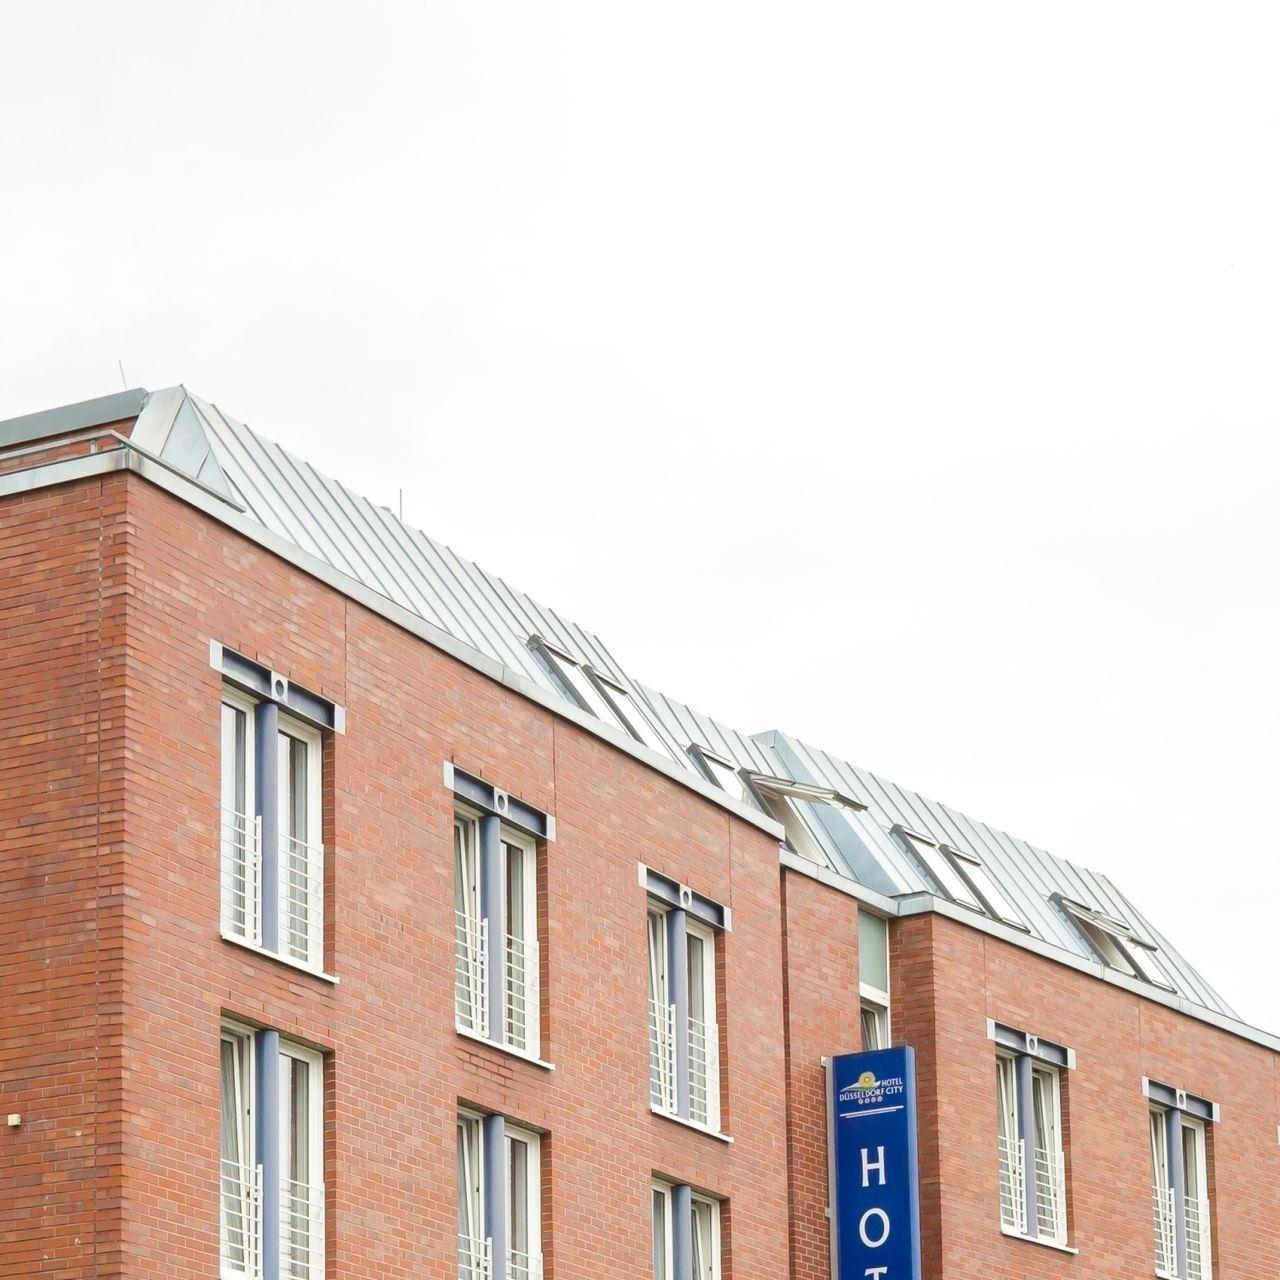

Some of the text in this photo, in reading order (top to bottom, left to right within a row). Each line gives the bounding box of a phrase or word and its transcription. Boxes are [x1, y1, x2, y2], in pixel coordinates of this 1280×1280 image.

[881, 1077, 904, 1087] HOTEL
[839, 1086, 904, 1102] DÜSSELDORF CITY
